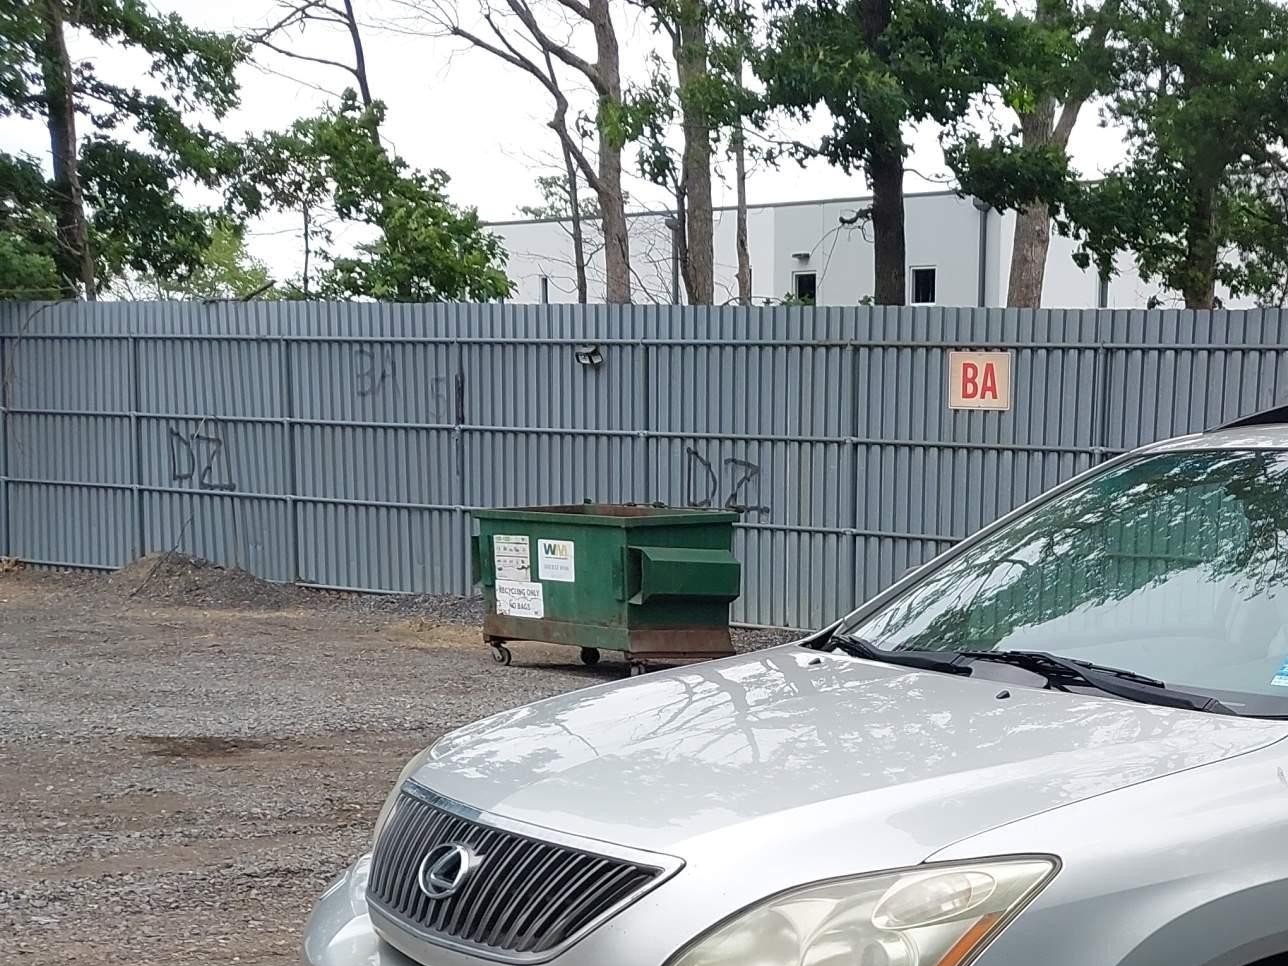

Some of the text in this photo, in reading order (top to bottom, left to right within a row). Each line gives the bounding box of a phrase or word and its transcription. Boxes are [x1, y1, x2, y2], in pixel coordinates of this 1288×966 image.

[962, 362, 998, 400] BA
[543, 543, 568, 556] WM
[498, 586, 540, 597] RECYCLING ONLY
